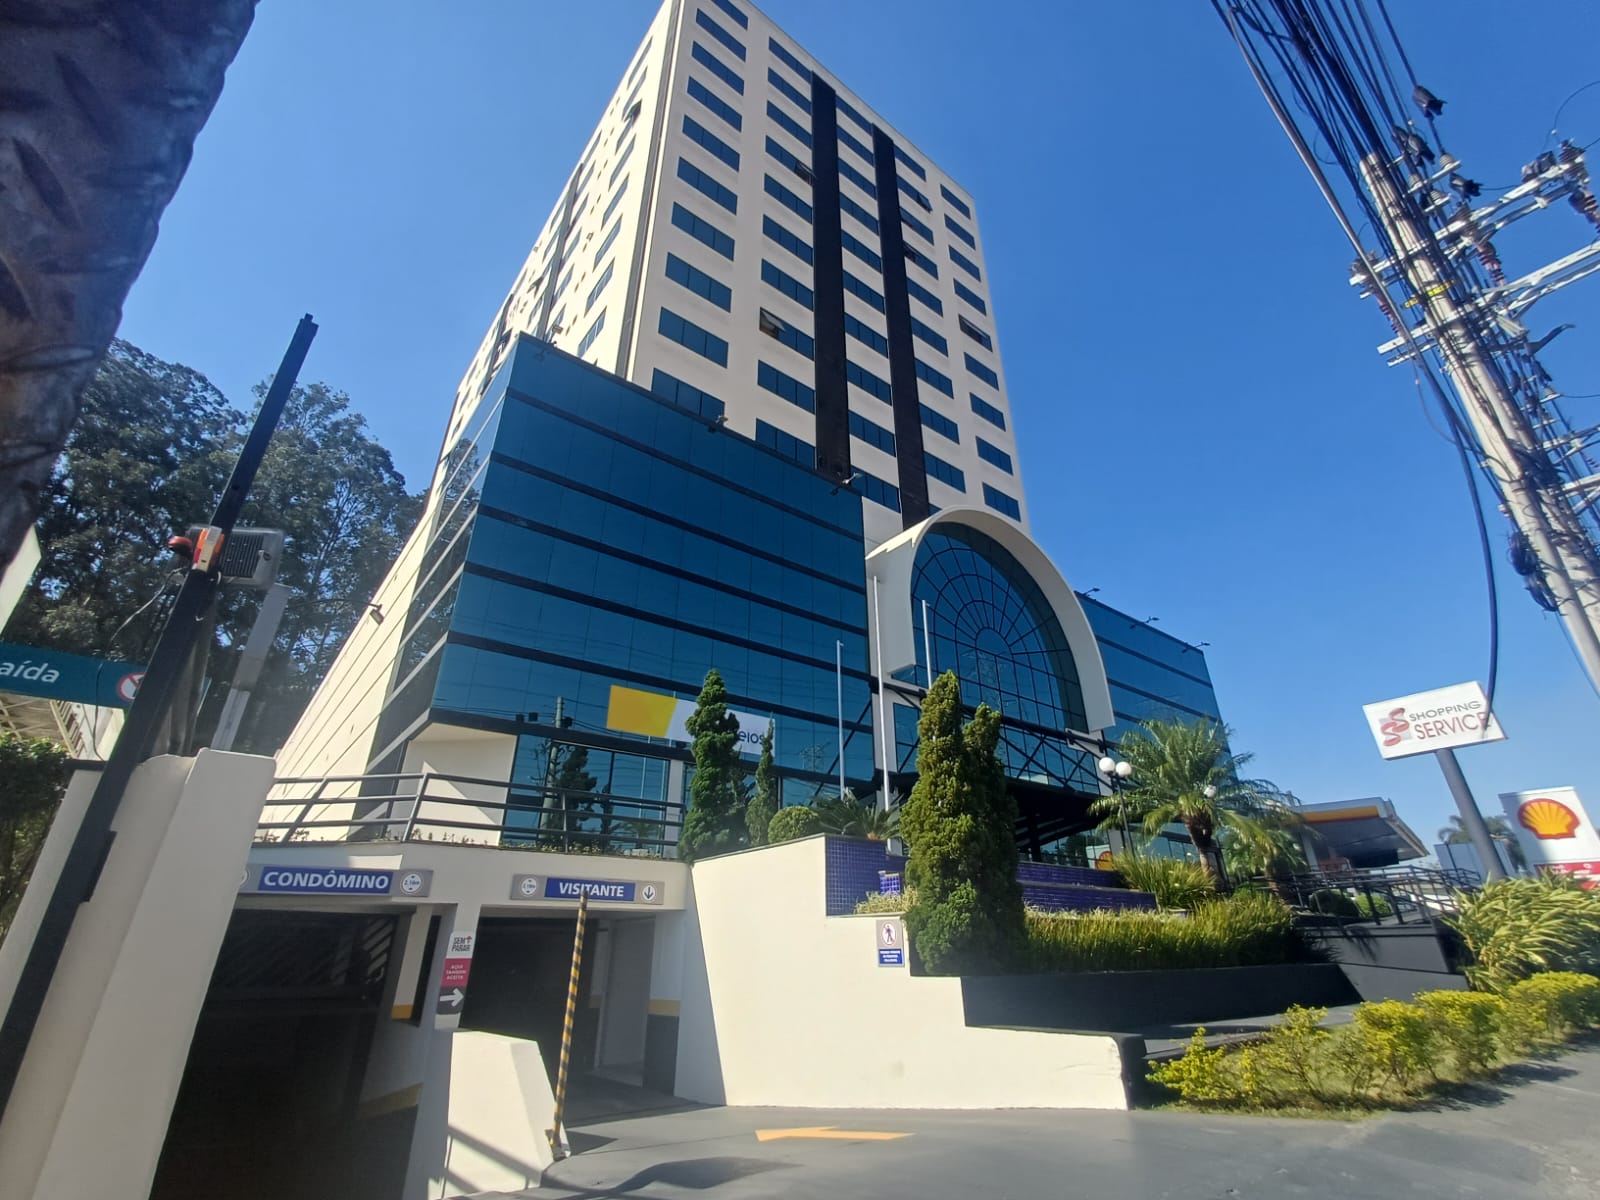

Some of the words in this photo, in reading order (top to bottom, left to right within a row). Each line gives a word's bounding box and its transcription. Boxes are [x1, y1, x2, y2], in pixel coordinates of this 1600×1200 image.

[0, 660, 60, 684] aída
[1409, 701, 1481, 722] SHOPPING
[1414, 712, 1490, 739] SERVICE
[263, 870, 390, 889] CONDÔMINO
[559, 882, 625, 897] VISITANTE
